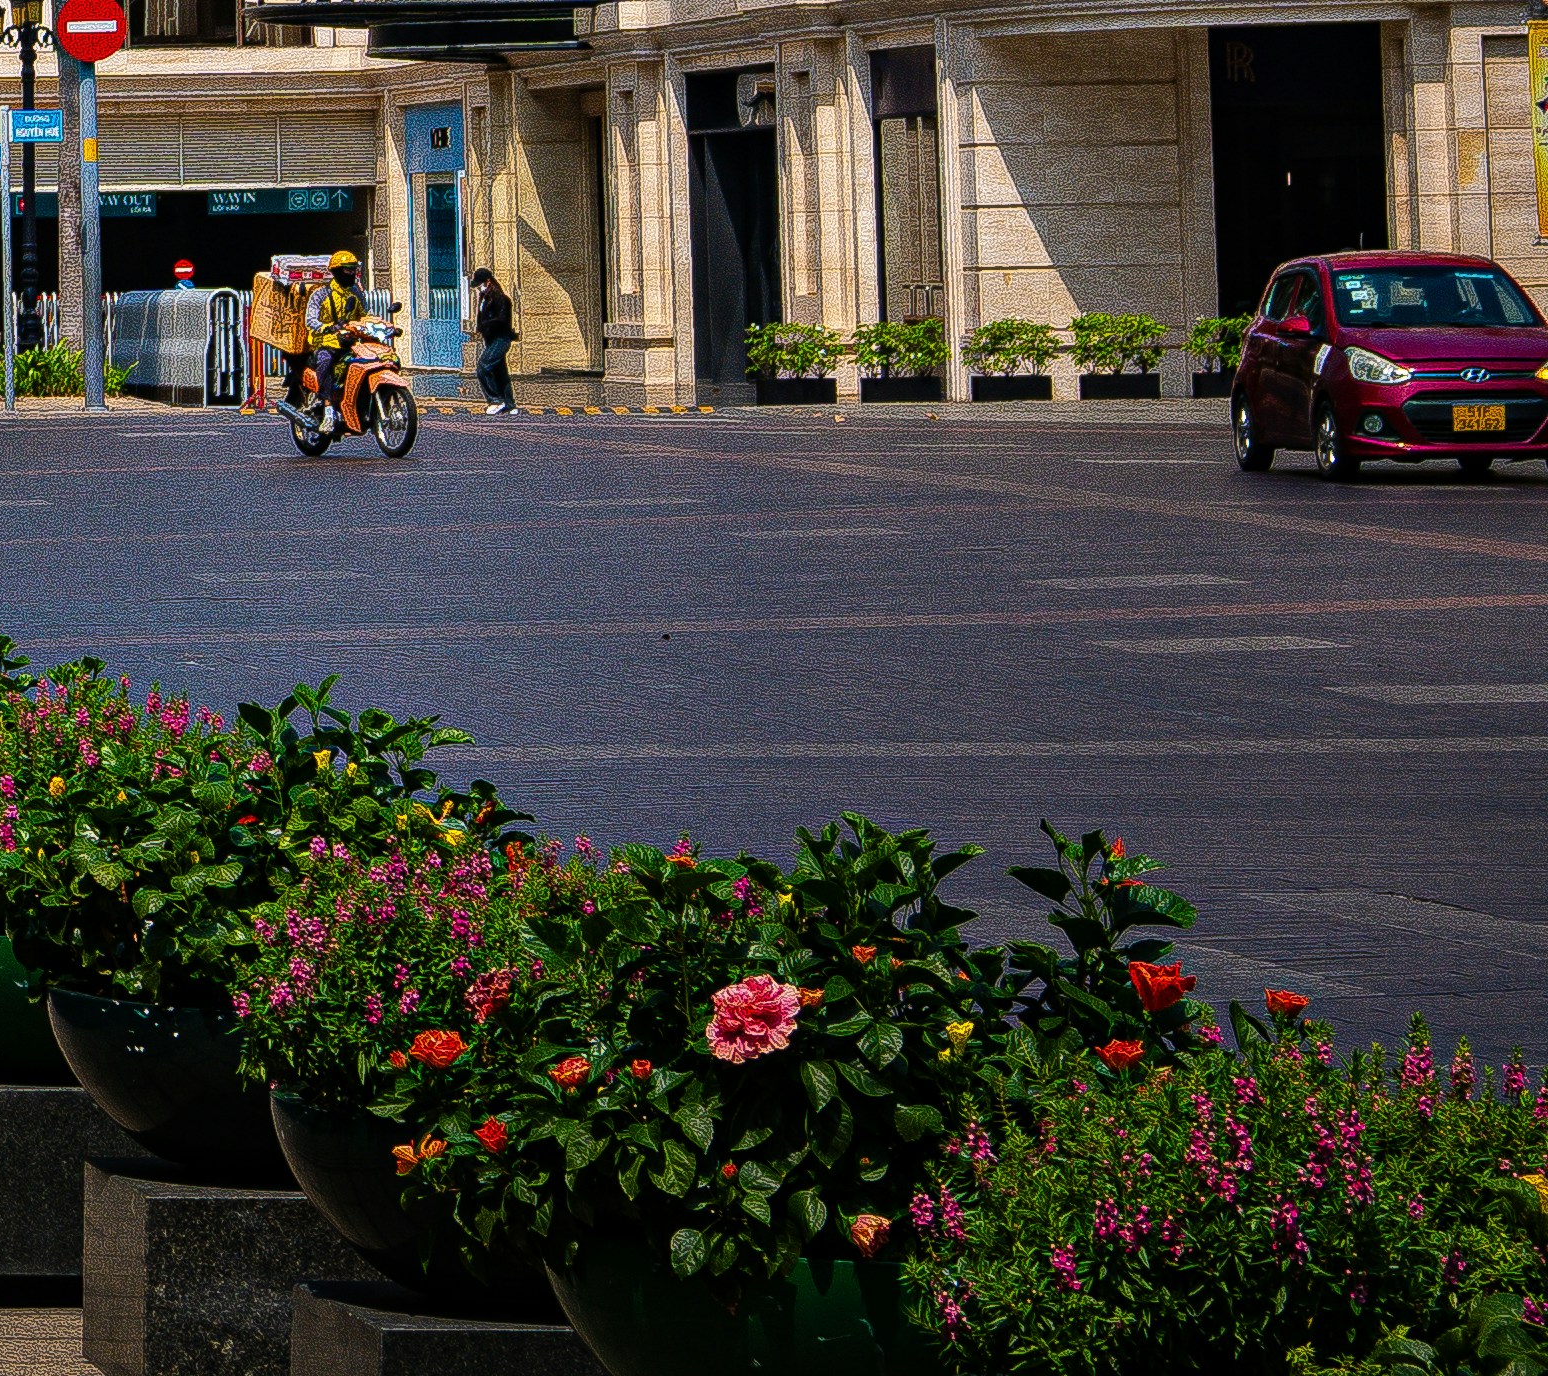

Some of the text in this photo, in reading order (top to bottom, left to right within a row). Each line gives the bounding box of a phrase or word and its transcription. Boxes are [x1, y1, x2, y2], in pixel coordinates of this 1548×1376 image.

[122, 194, 152, 206] OUT
[212, 192, 257, 204] WAY IN
